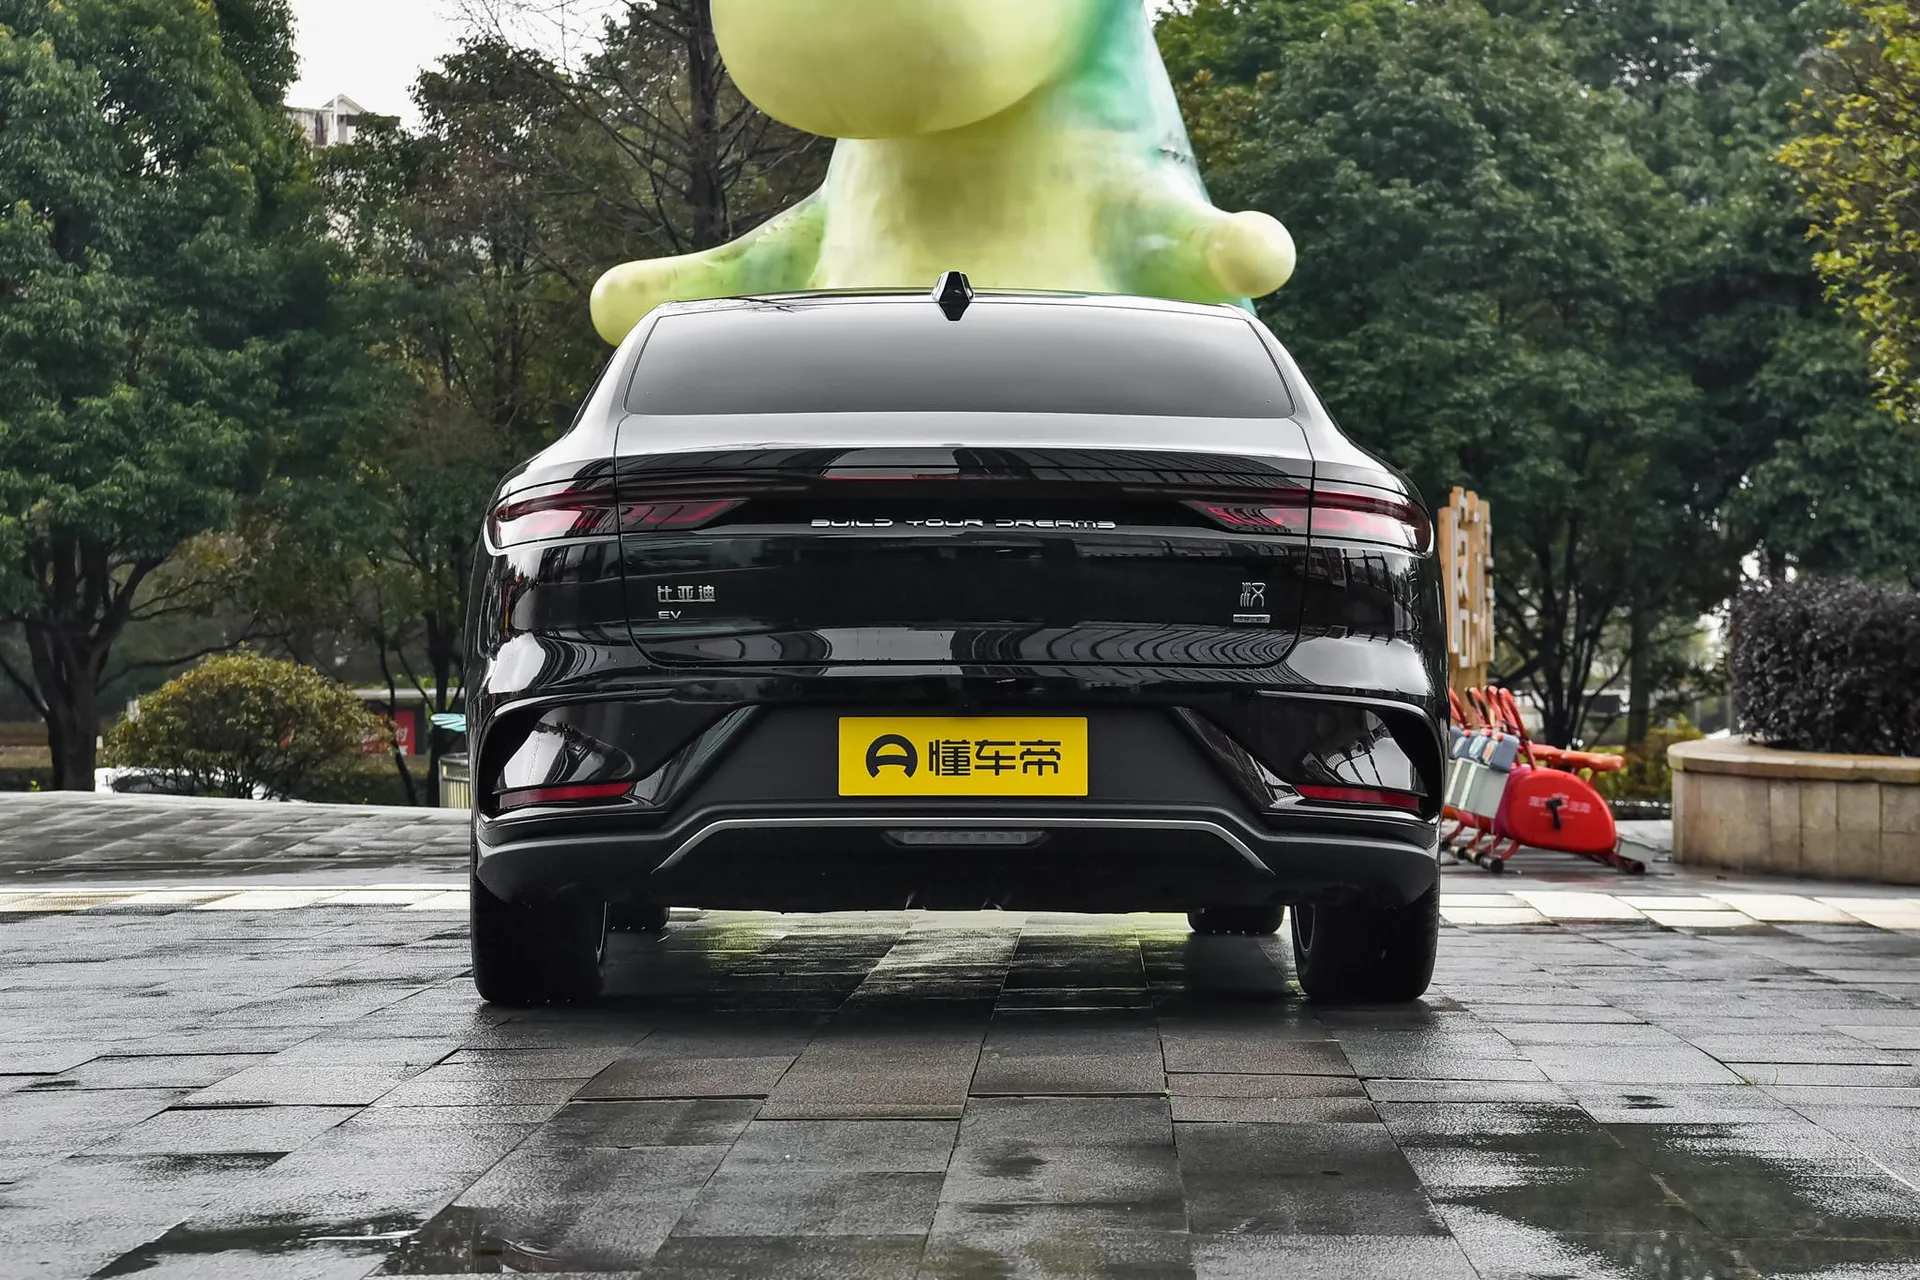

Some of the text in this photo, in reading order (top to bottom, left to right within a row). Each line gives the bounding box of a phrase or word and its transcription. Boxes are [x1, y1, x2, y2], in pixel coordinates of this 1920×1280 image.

[810, 518, 1116, 529] BUILD YOUR DREAMS
[657, 585, 715, 602] 比亚迪
[1240, 582, 1266, 607] 汉
[658, 610, 681, 619] EV
[928, 739, 1061, 776] 懂车帝
